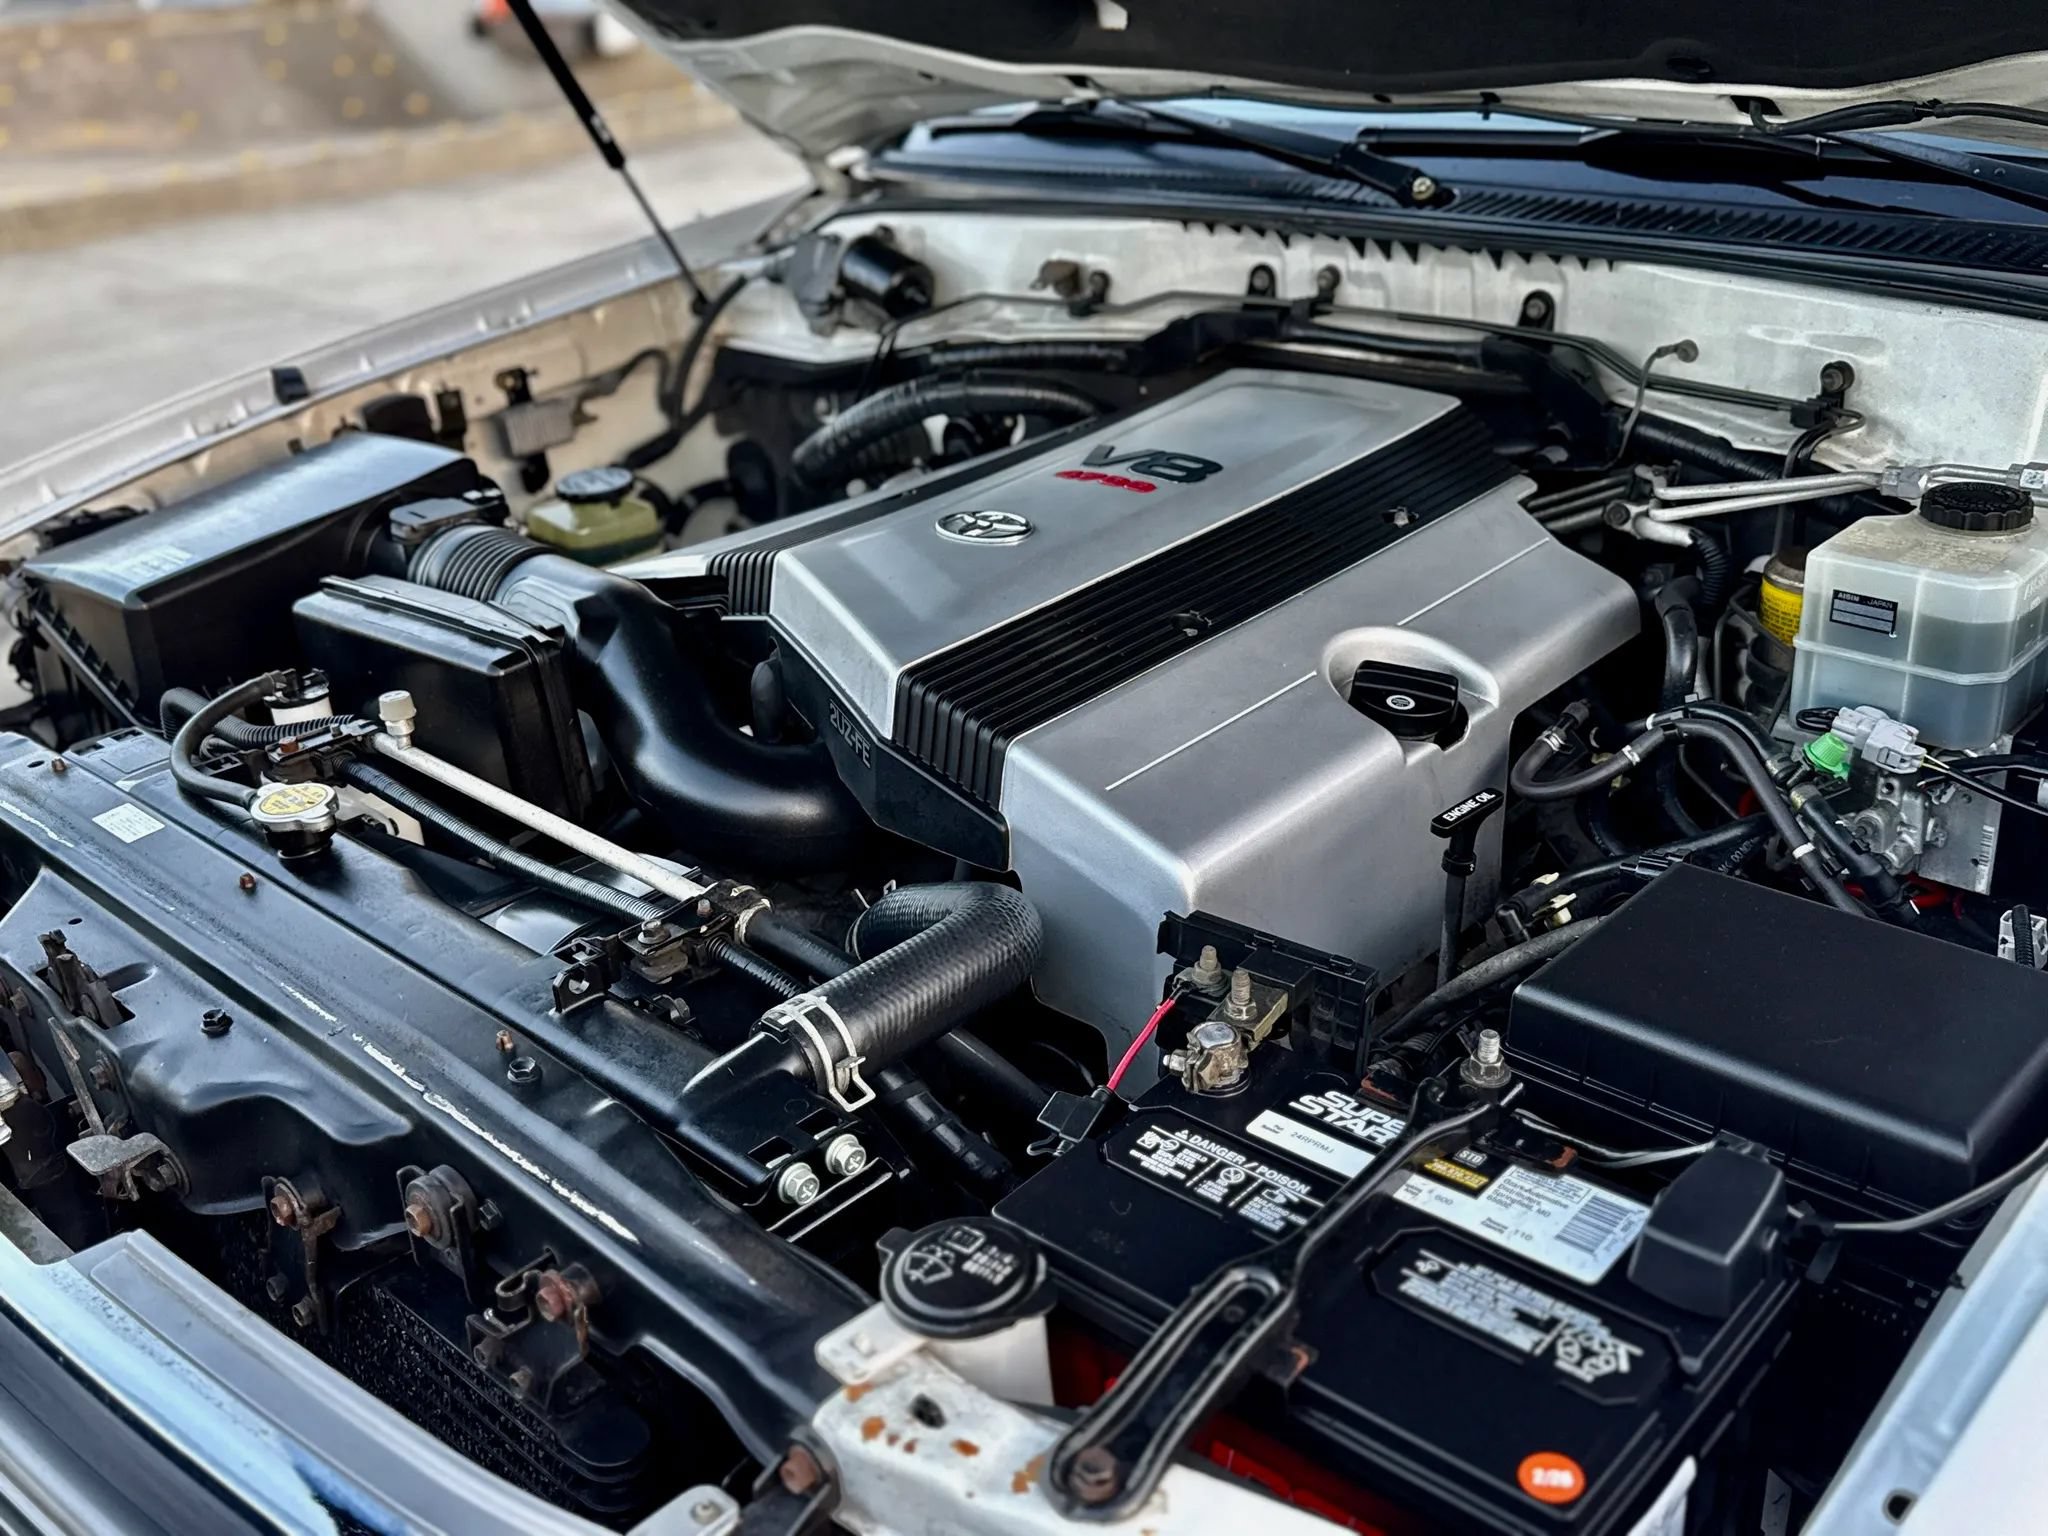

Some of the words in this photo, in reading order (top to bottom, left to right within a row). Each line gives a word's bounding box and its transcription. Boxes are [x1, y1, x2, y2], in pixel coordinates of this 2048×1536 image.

[1081, 444, 1223, 484] V8
[1838, 592, 1860, 602] AISIN
[1867, 599, 1893, 609] JAPAN
[829, 702, 871, 769] 2UZ-FE
[1442, 799, 1481, 822] ENGINE
[1475, 791, 1497, 803] OIL
[1288, 1095, 1398, 1144] STAR
[1315, 1090, 1406, 1135] SUPE
[1189, 1134, 1246, 1166] DANGER
[1255, 1165, 1312, 1194] POISON
